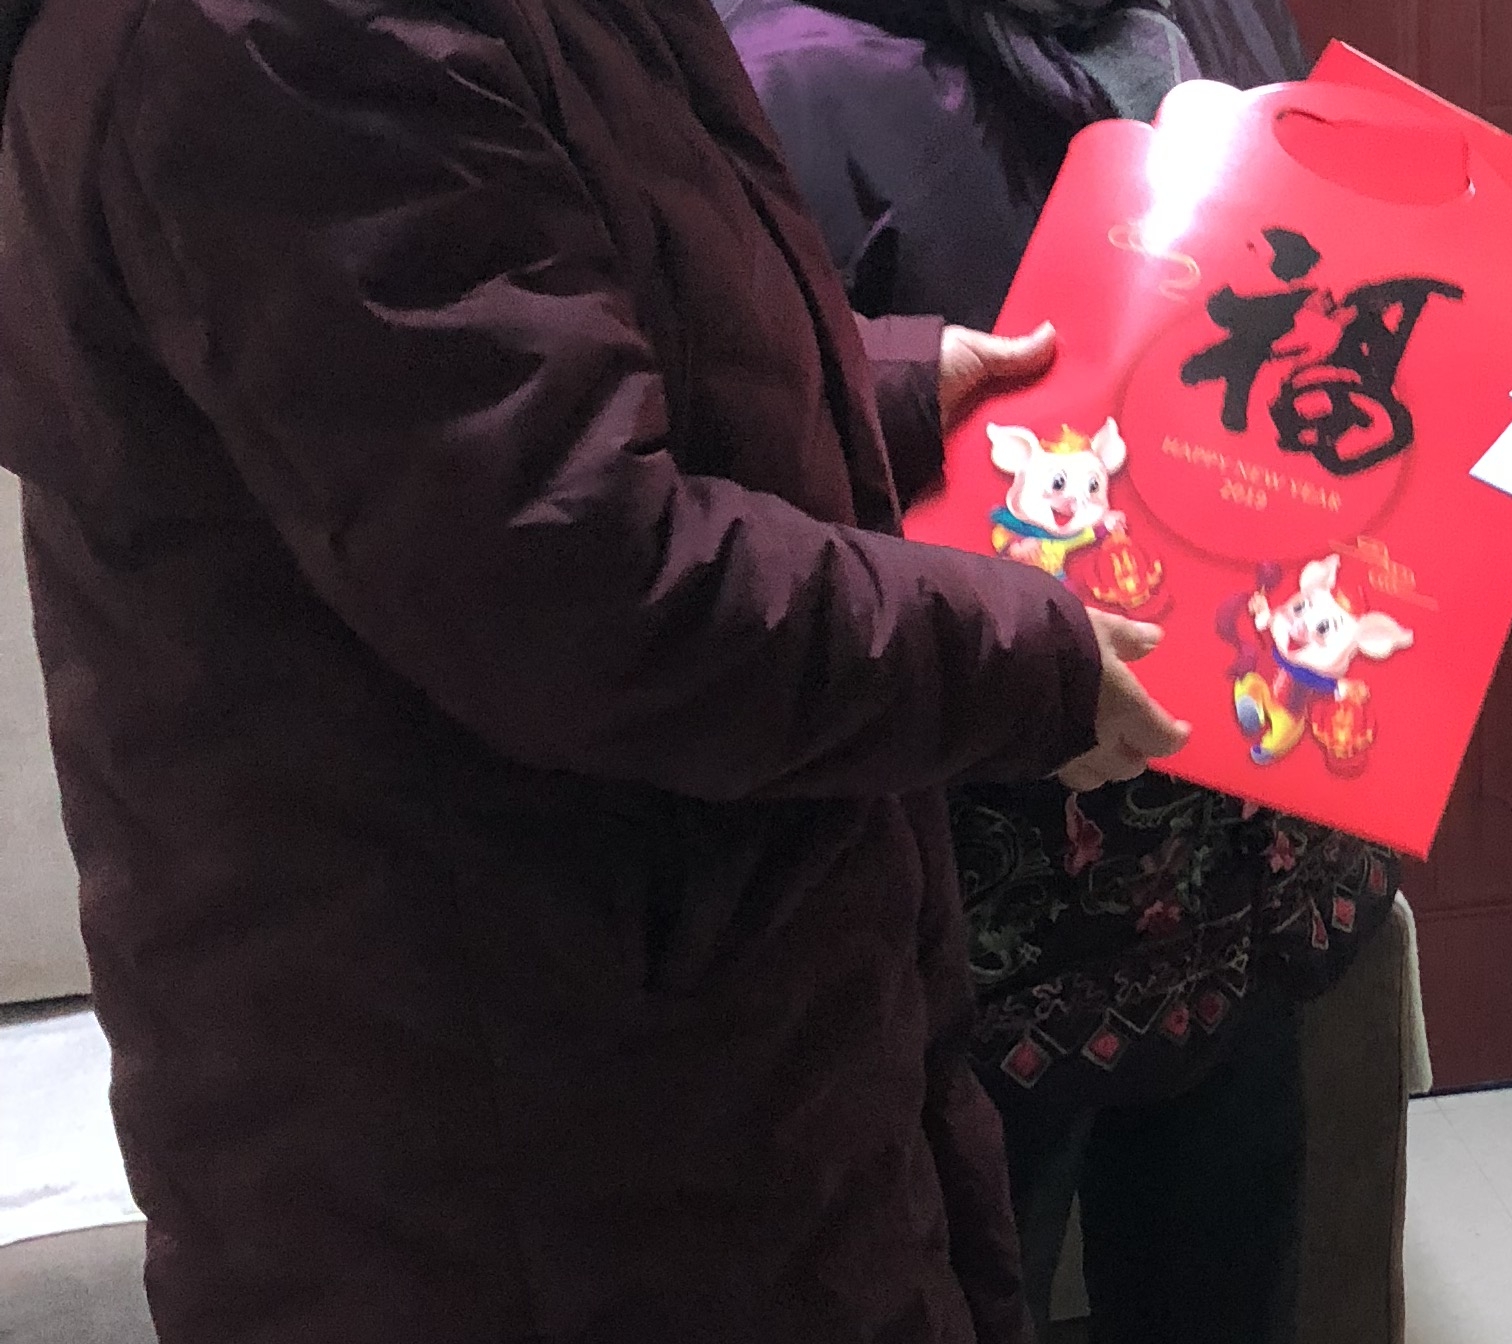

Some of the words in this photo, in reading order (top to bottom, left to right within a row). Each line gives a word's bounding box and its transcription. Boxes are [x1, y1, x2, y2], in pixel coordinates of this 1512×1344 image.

[1181, 227, 1465, 477] 福
[1161, 436, 1227, 473] HAPPY
[1236, 459, 1281, 491] NEW
[1290, 477, 1343, 513] YEAR
